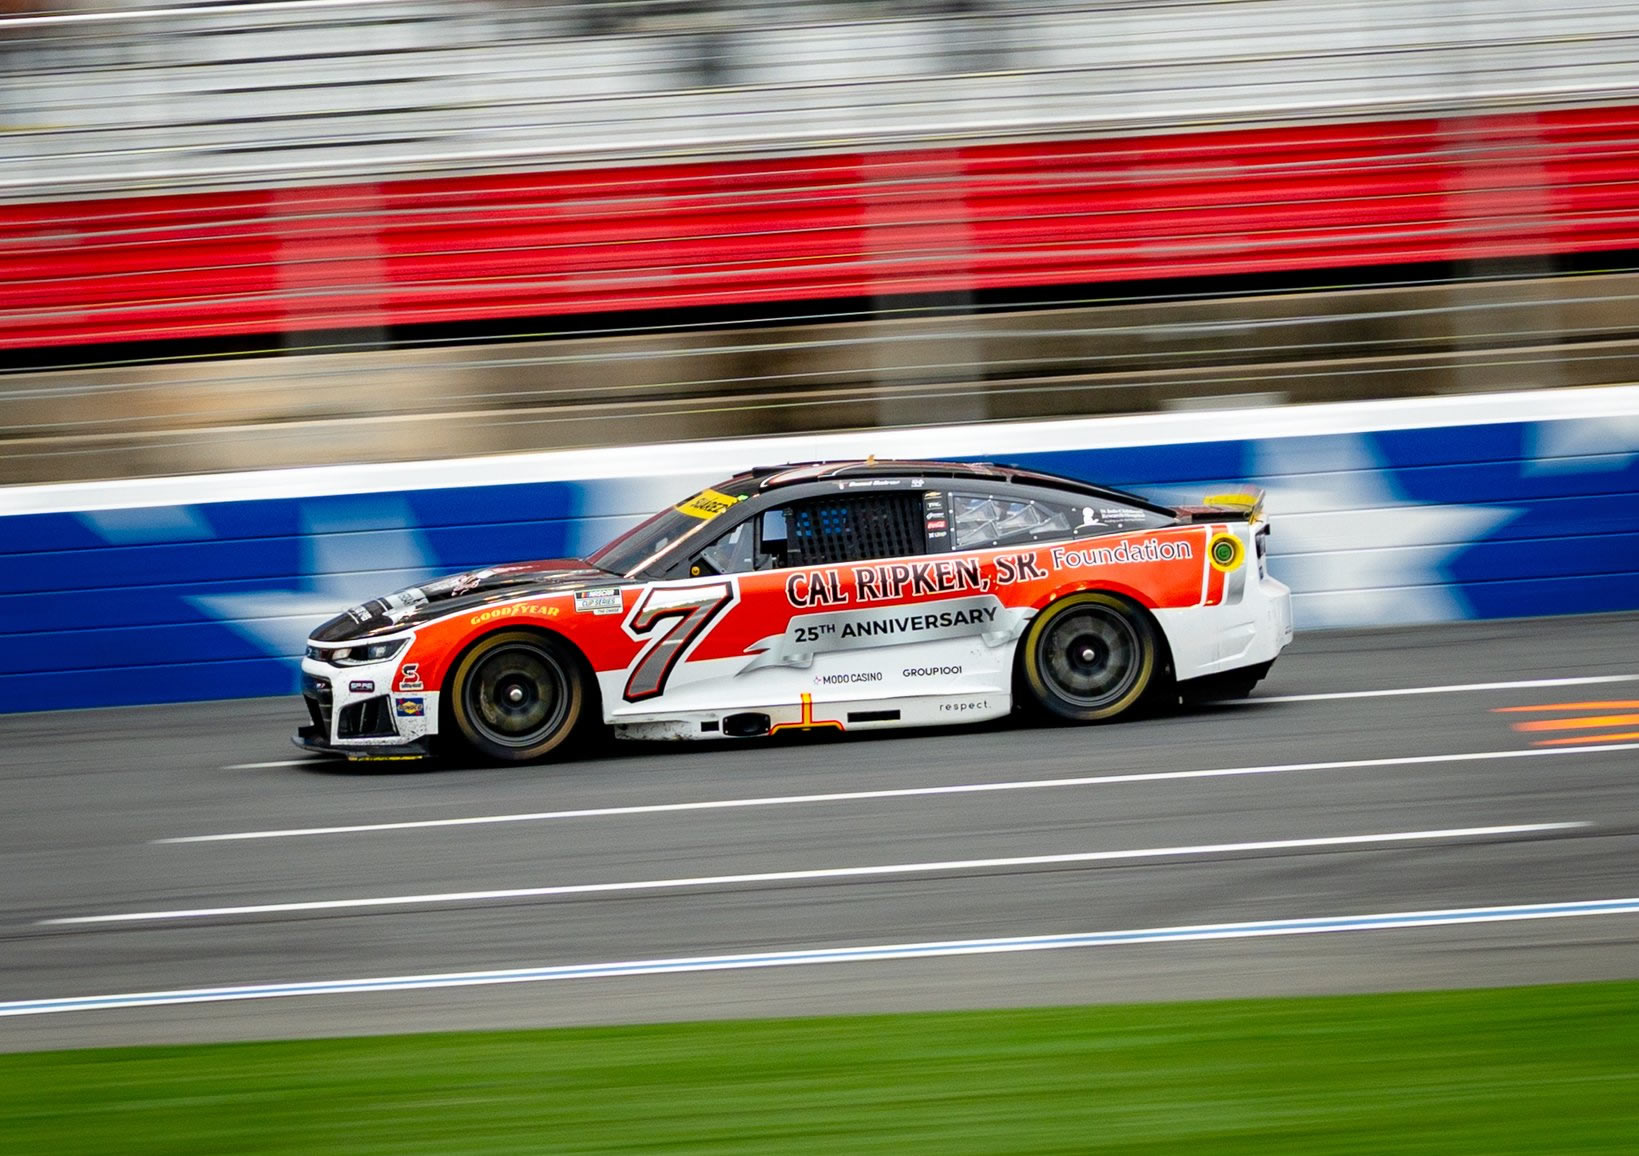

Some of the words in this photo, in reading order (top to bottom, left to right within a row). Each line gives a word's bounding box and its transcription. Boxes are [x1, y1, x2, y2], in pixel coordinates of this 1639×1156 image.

[785, 569, 849, 608] CAL
[853, 557, 990, 602] RIPKEN,
[993, 550, 1048, 586] SR.
[1050, 538, 1193, 571] Foundation
[594, 598, 616, 607] SERIES
[470, 602, 560, 625] GOODYEAR
[794, 624, 836, 643] 25TH
[840, 606, 998, 639] ANNIVERSARY
[622, 580, 735, 704] 7
[823, 674, 849, 685] MODO
[851, 671, 883, 683] CASINO
[902, 665, 963, 678] GROUP1001
[939, 700, 992, 713] respect.
